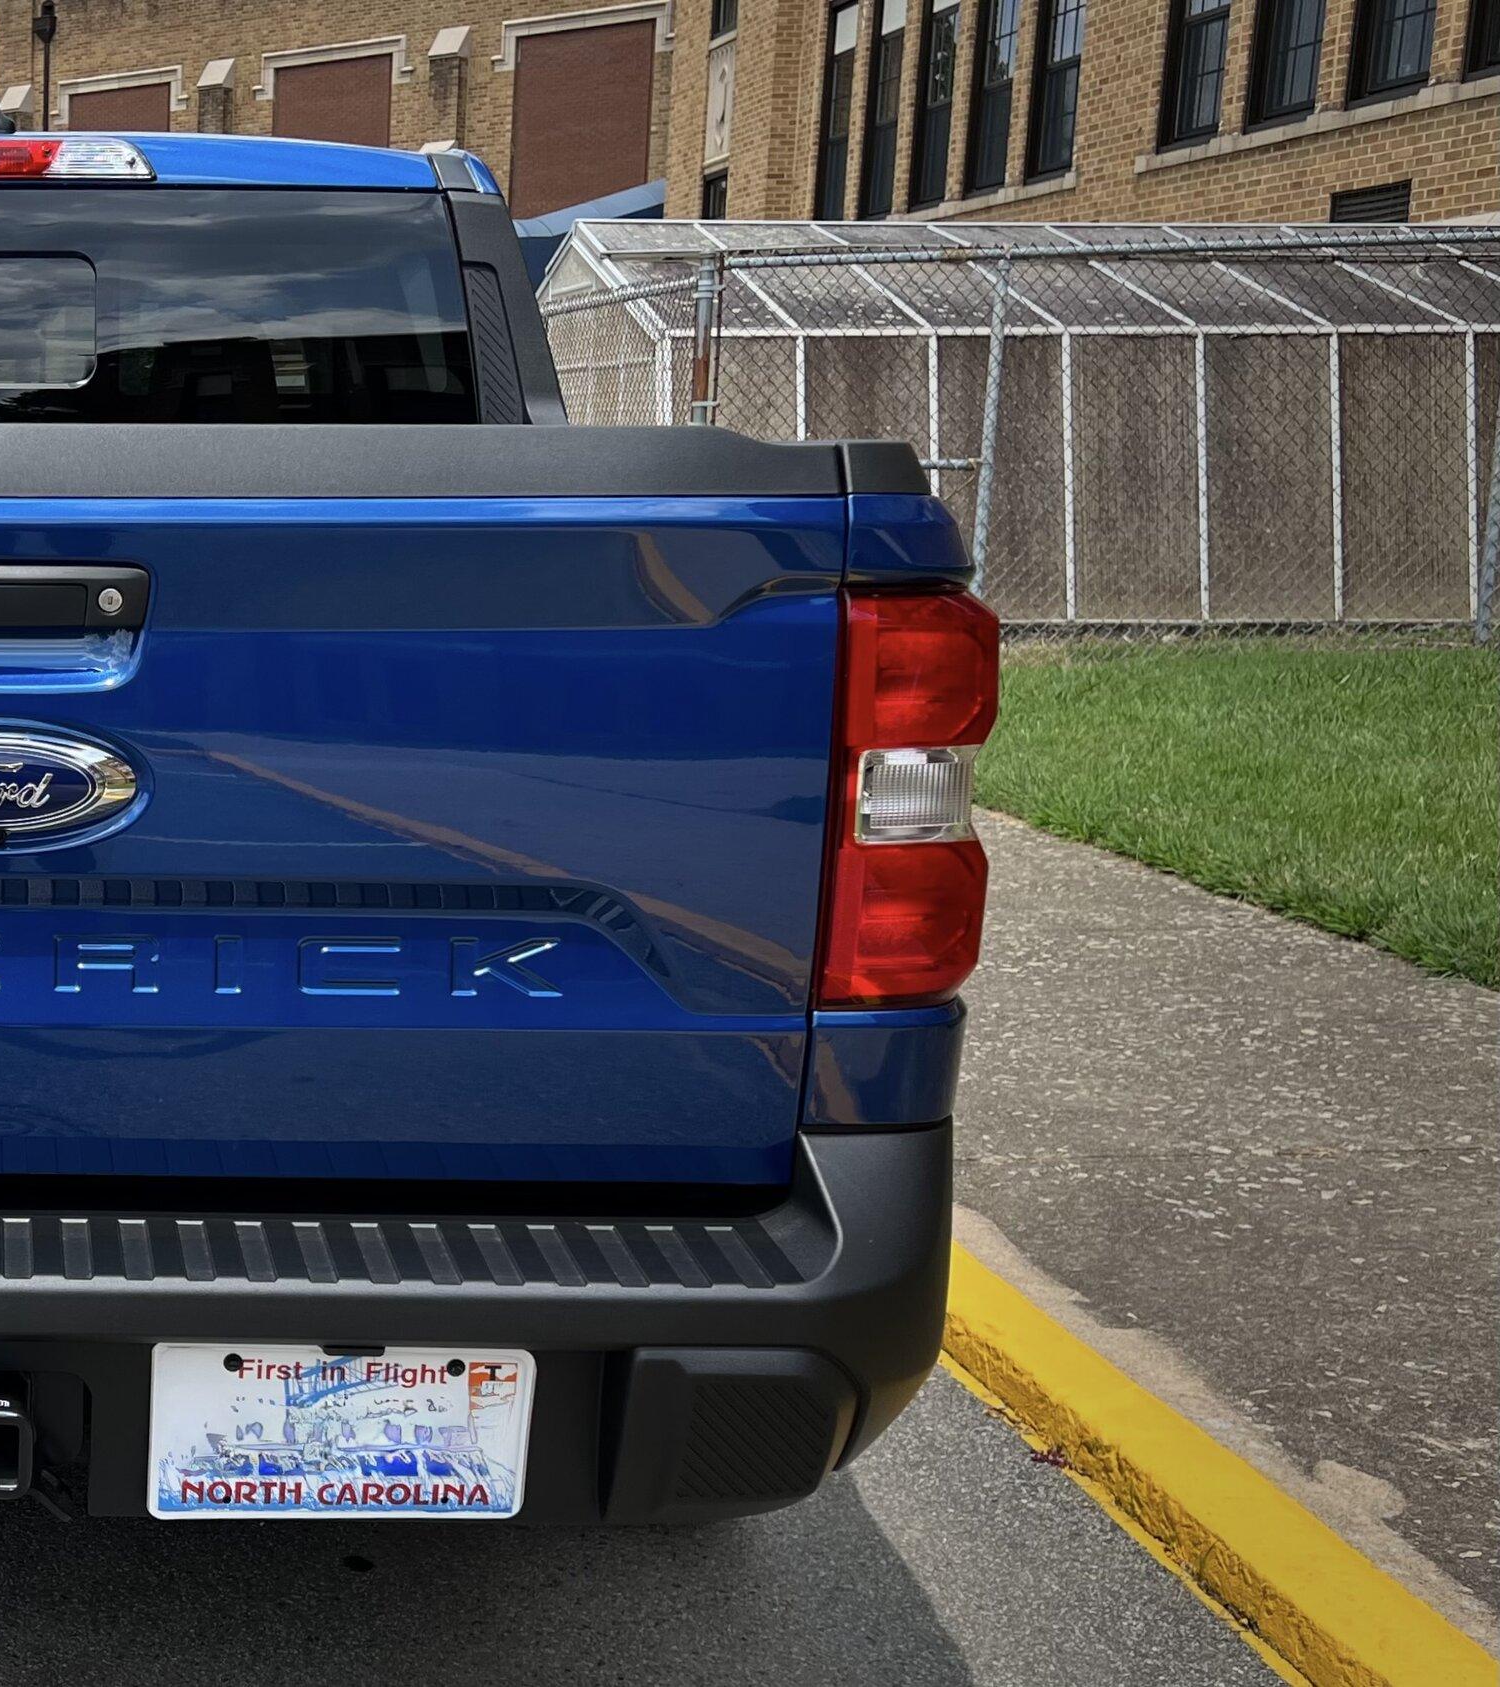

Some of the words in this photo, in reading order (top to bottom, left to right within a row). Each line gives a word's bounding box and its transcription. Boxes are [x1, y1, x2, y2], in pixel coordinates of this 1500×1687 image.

[238, 1358, 303, 1381] First
[322, 1360, 346, 1382] in
[366, 1361, 448, 1389] Flight
[181, 1479, 303, 1505] NORTH
[316, 1481, 491, 1506] CAROLINA
